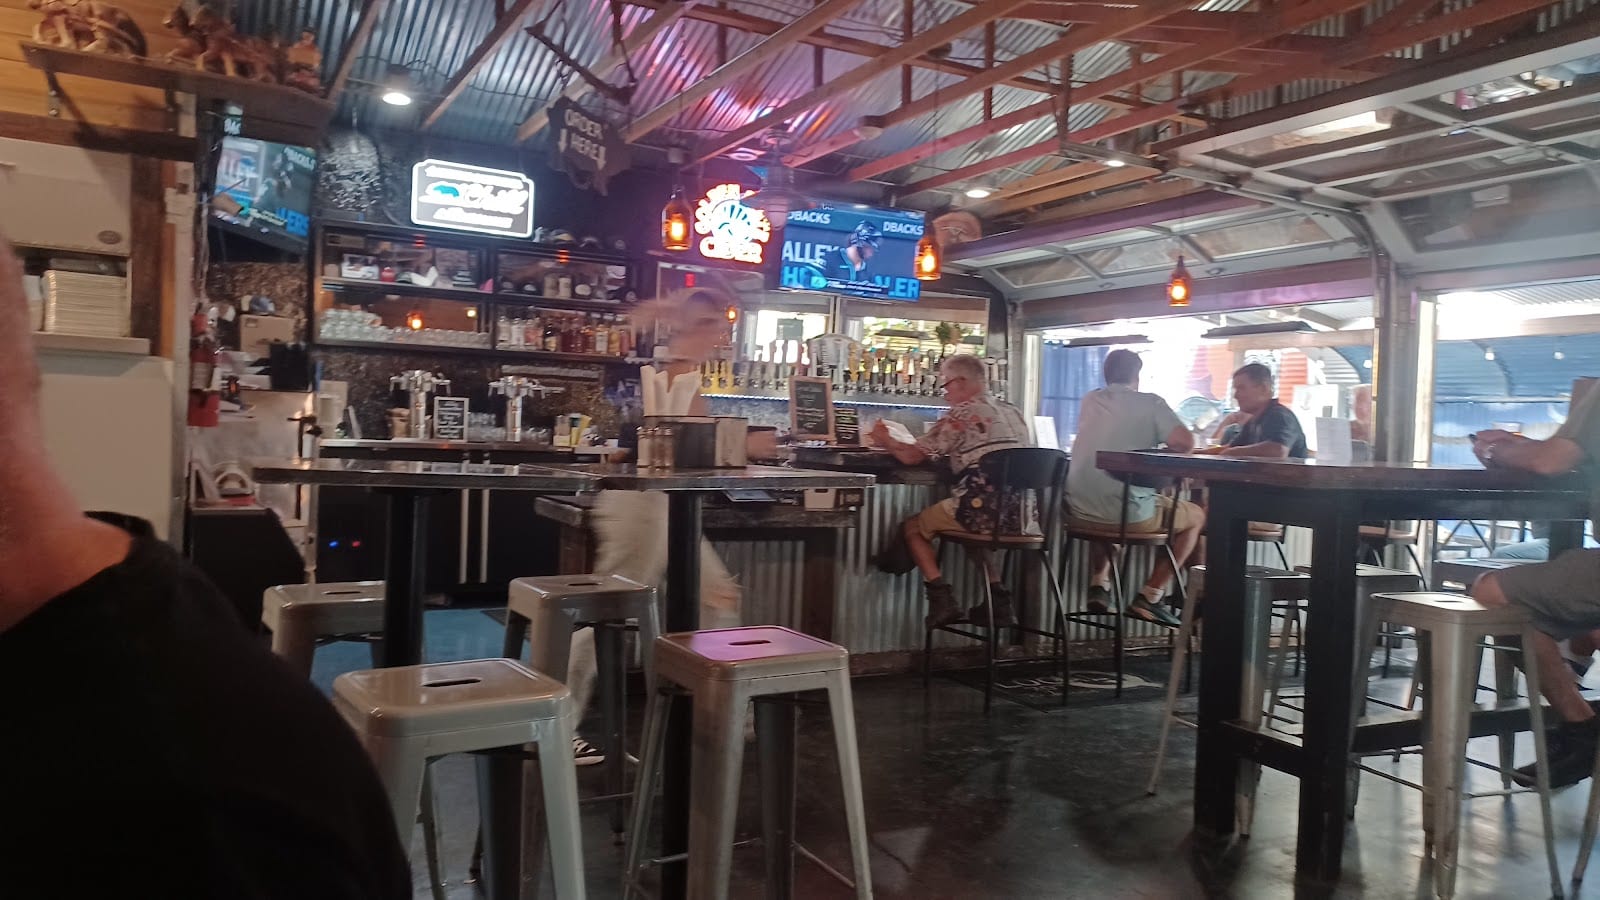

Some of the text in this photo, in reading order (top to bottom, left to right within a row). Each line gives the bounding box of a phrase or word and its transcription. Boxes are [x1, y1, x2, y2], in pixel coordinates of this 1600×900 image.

[564, 109, 603, 140] ORDER
[571, 132, 600, 160] HERE
[883, 221, 924, 236] DBACKS
[700, 237, 762, 263] CIDER
